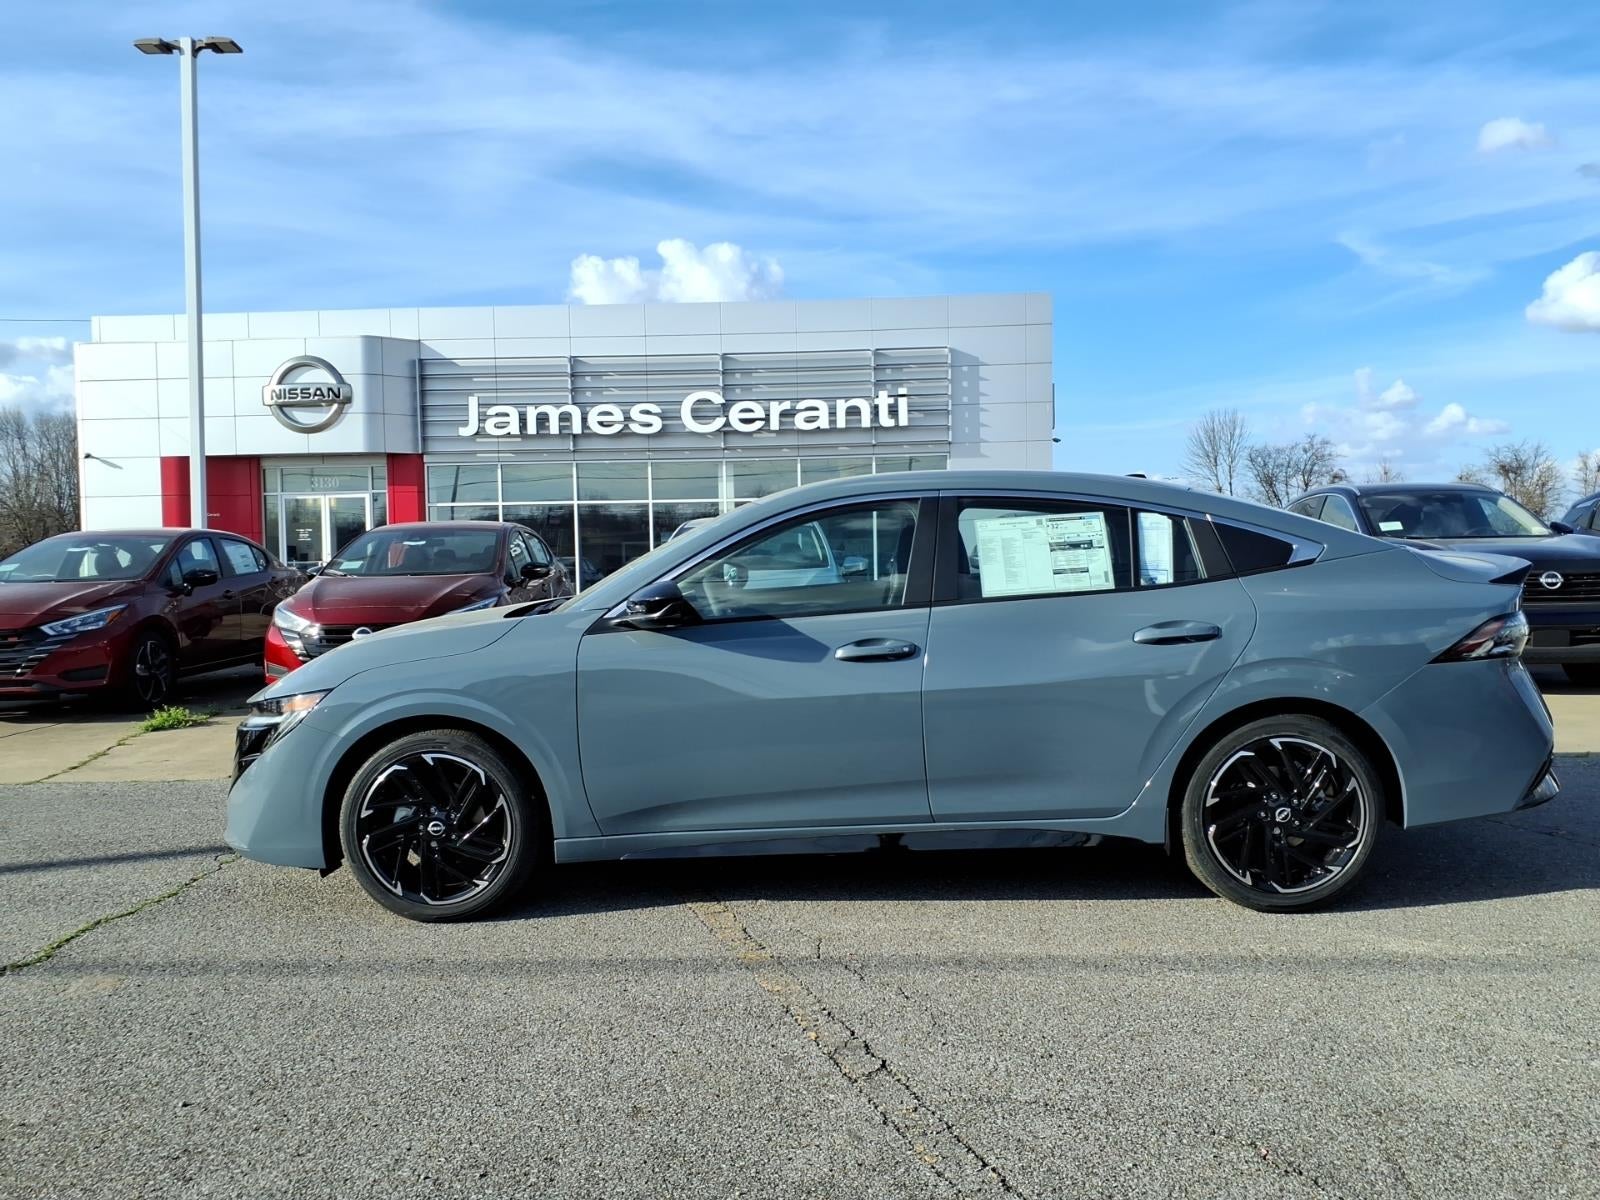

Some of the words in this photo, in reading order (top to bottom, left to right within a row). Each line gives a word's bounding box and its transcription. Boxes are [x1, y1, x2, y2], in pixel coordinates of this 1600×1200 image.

[270, 386, 341, 401] NISSAN
[458, 395, 664, 437] James
[680, 387, 910, 434] Ceranti
